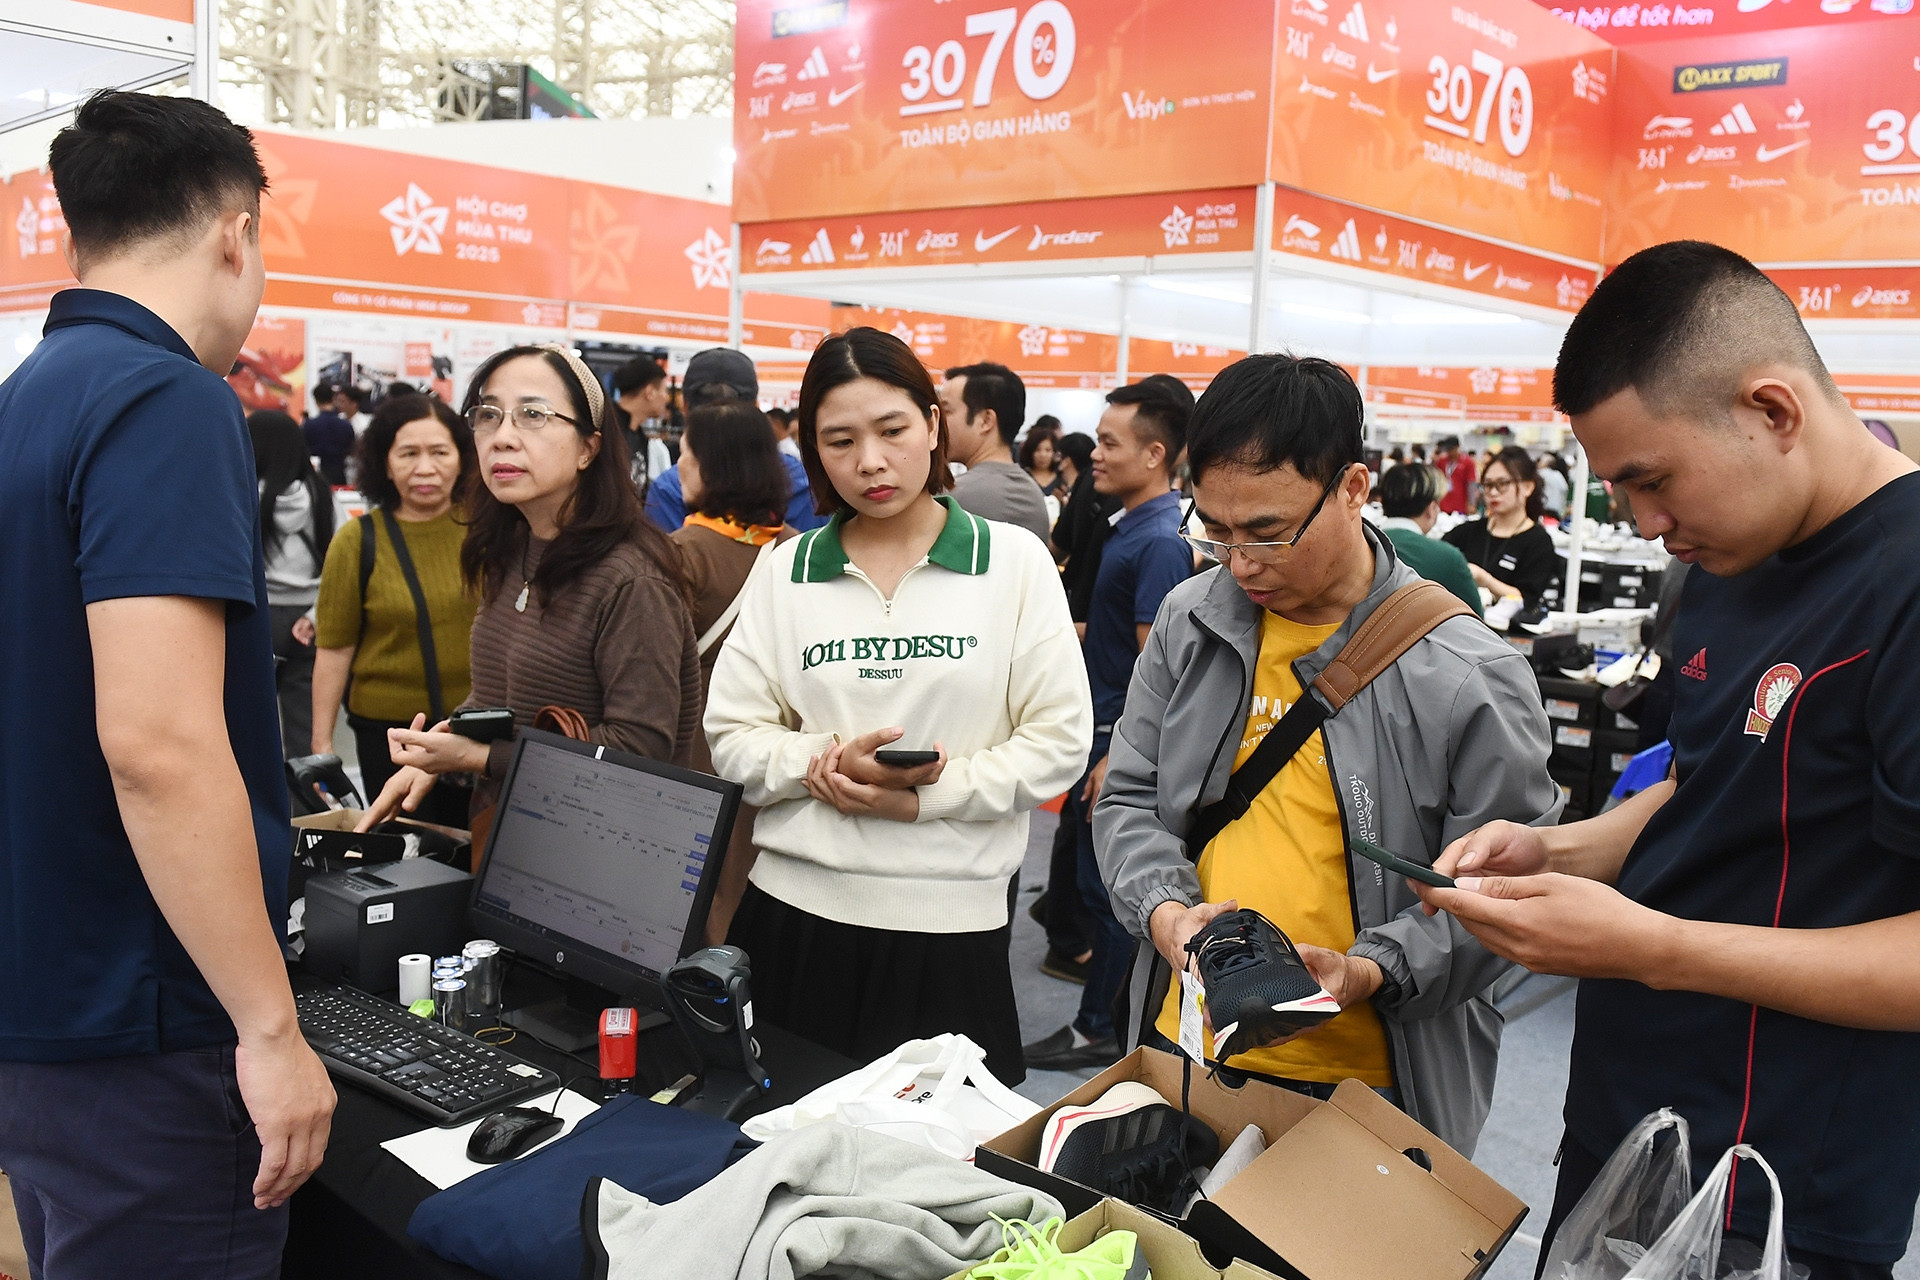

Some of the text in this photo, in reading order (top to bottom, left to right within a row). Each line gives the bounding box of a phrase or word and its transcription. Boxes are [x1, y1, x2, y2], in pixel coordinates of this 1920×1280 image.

[1576, 6, 1610, 31] hội
[1611, 3, 1640, 27] để
[1640, 4, 1670, 27] tốt
[1672, 4, 1714, 26] hơn
[901, 108, 1071, 149] TOÀN BỘ GIAN HÀNG
[1860, 182, 1920, 206] TOÀN
[456, 195, 528, 224] HỘI CHỢ
[456, 218, 533, 244] MÙA THU
[1041, 229, 1103, 245] rider
[456, 242, 500, 263] 2025
[801, 638, 846, 671] 1011
[852, 636, 890, 661] BY
[858, 668, 903, 680] DESSUU
[1680, 665, 1708, 682] adidas
[1759, 683, 1768, 709] Junior
[1774, 667, 1793, 677] Senior
[1349, 774, 1362, 809] TKOUO
